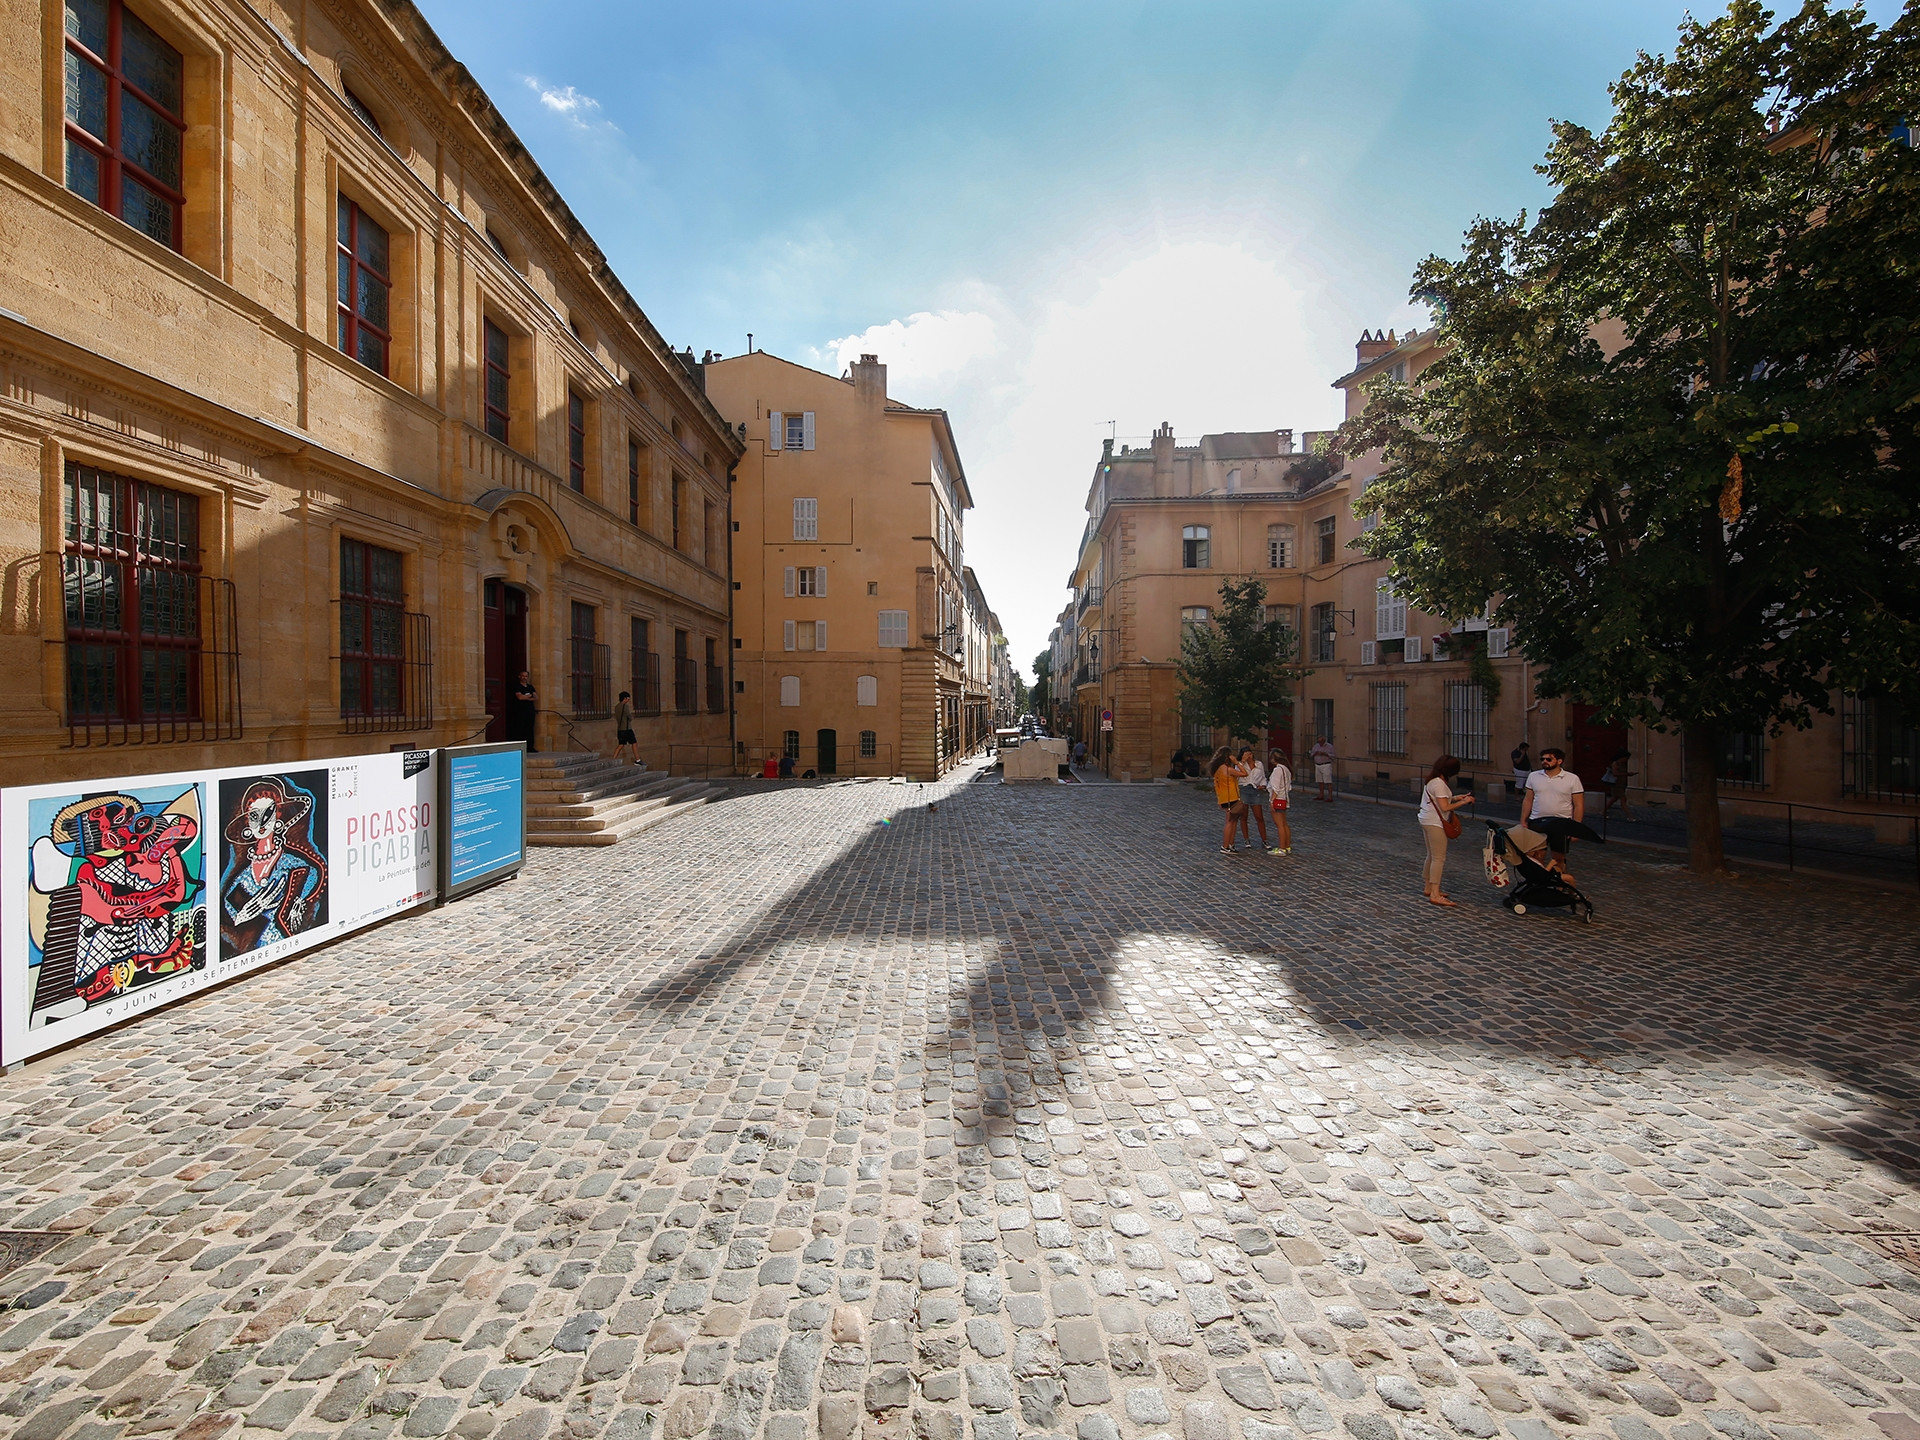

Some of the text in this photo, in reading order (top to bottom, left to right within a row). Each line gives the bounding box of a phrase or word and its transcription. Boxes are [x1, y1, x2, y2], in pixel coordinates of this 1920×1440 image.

[331, 765, 358, 773] GRANET
[347, 802, 431, 846] PICASSO
[347, 829, 430, 877] PICABIA
[386, 867, 411, 879] Peinture
[105, 1008, 113, 1017] 9
[123, 991, 157, 1011] JUIN
[181, 978, 195, 989] 23
[203, 949, 269, 981] SEPTEMBRE
[275, 939, 300, 953] 2018
